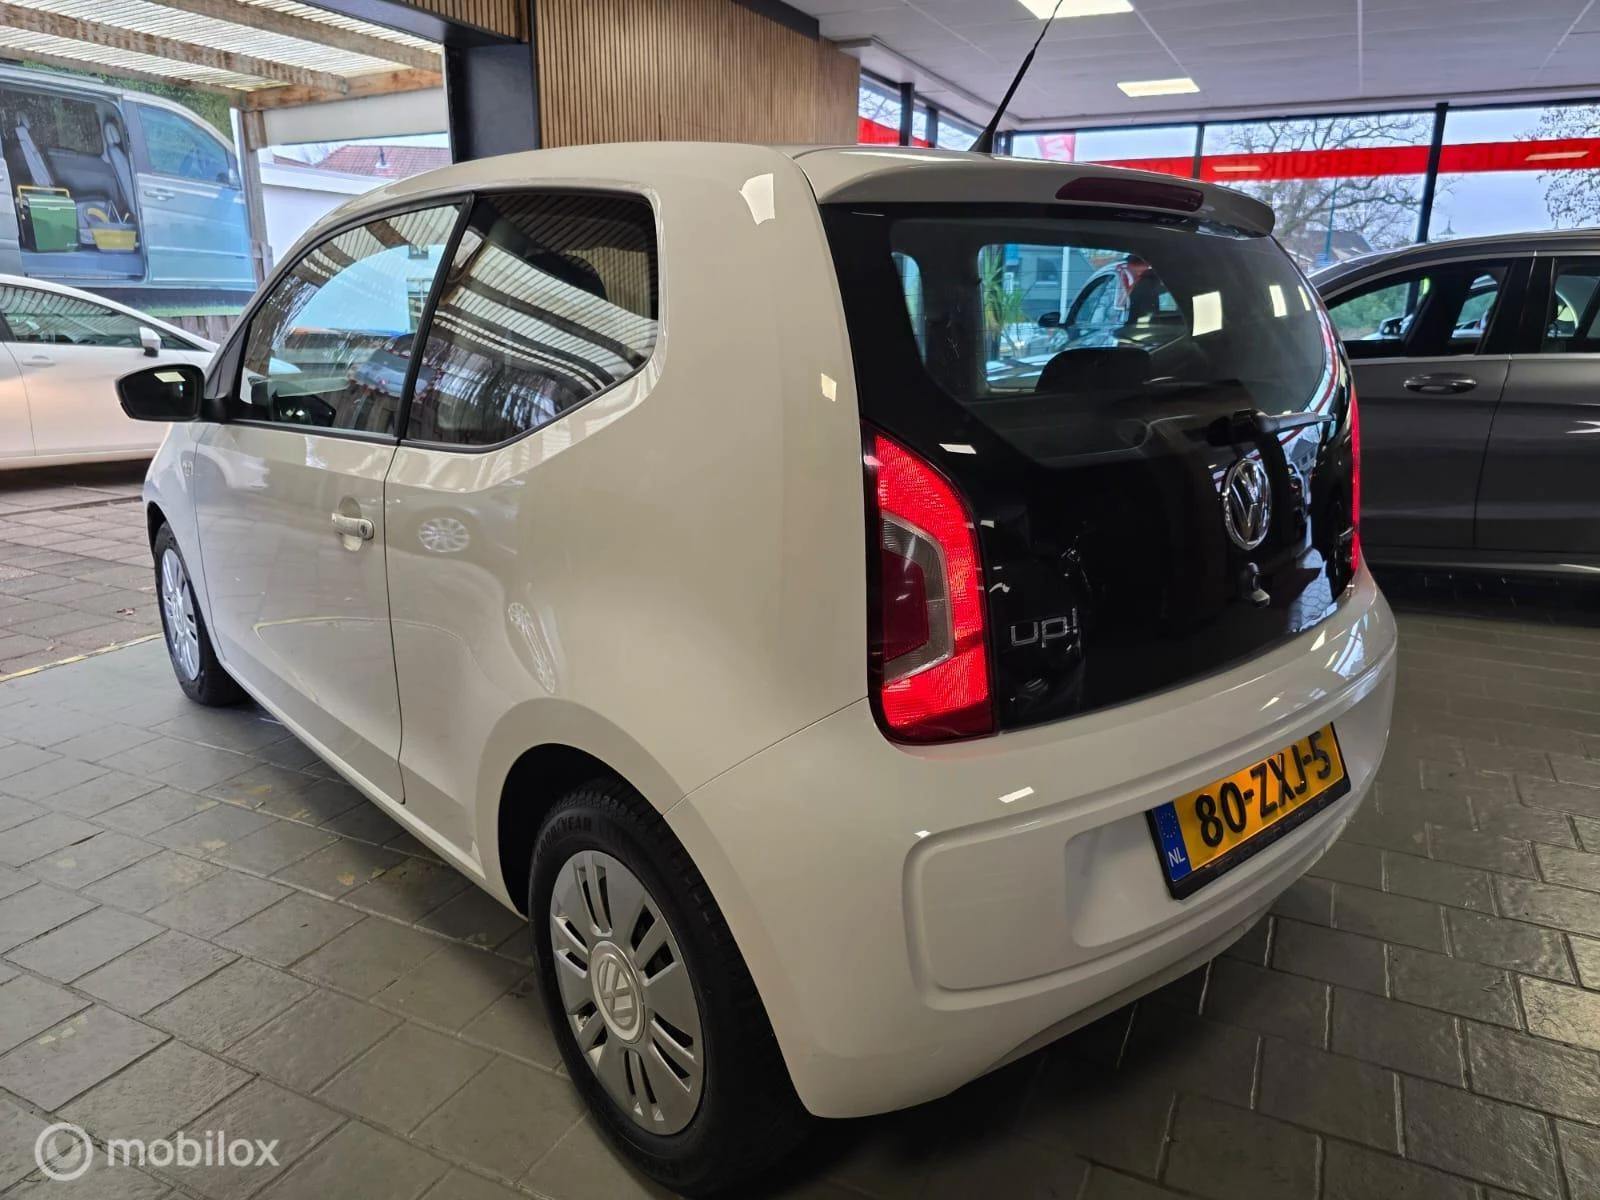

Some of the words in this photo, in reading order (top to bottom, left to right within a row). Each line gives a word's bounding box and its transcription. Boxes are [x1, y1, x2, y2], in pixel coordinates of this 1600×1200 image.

[1010, 607, 1078, 649] up!
[1195, 731, 1332, 848] 80-ZXJ-5
[1167, 847, 1186, 867] NL
